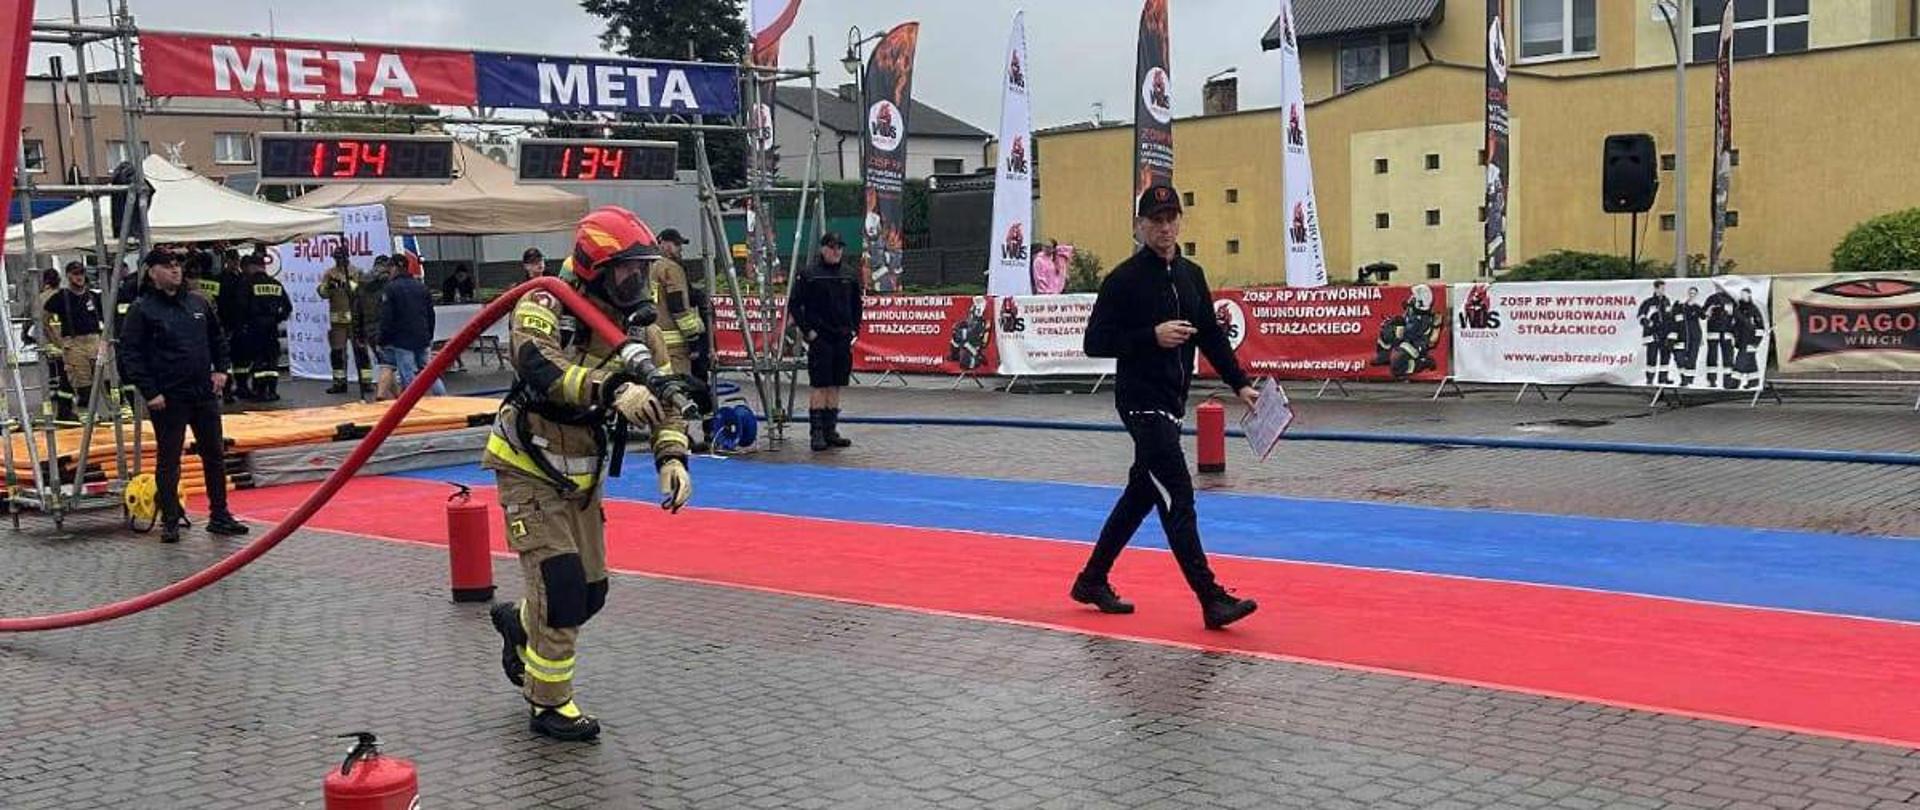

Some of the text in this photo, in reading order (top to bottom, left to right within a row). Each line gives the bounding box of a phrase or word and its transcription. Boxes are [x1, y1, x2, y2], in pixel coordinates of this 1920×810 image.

[211, 45, 419, 97] META
[537, 63, 699, 109] META
[1243, 286, 1382, 302] ZOSP RP WYTWÓRNIA
[1500, 294, 1637, 306] ZOSP RP WYTWÓRNIA
[1252, 305, 1371, 318] UMUNDUROWANIA
[1510, 309, 1626, 321] UMUNDUROWANIA
[1032, 315, 1087, 324] UMUNDUROW
[1459, 309, 1501, 329] WUS
[1808, 313, 1919, 333] DRAGO
[1260, 320, 1361, 335] STRAŻACKIEGO
[1517, 323, 1617, 336] STRAŻACKIEGO
[1844, 335, 1902, 346] WINCH
[1250, 359, 1366, 371] www.wusbrzeziny.pl
[1503, 351, 1633, 366] www.wusbrzeziny.pl
